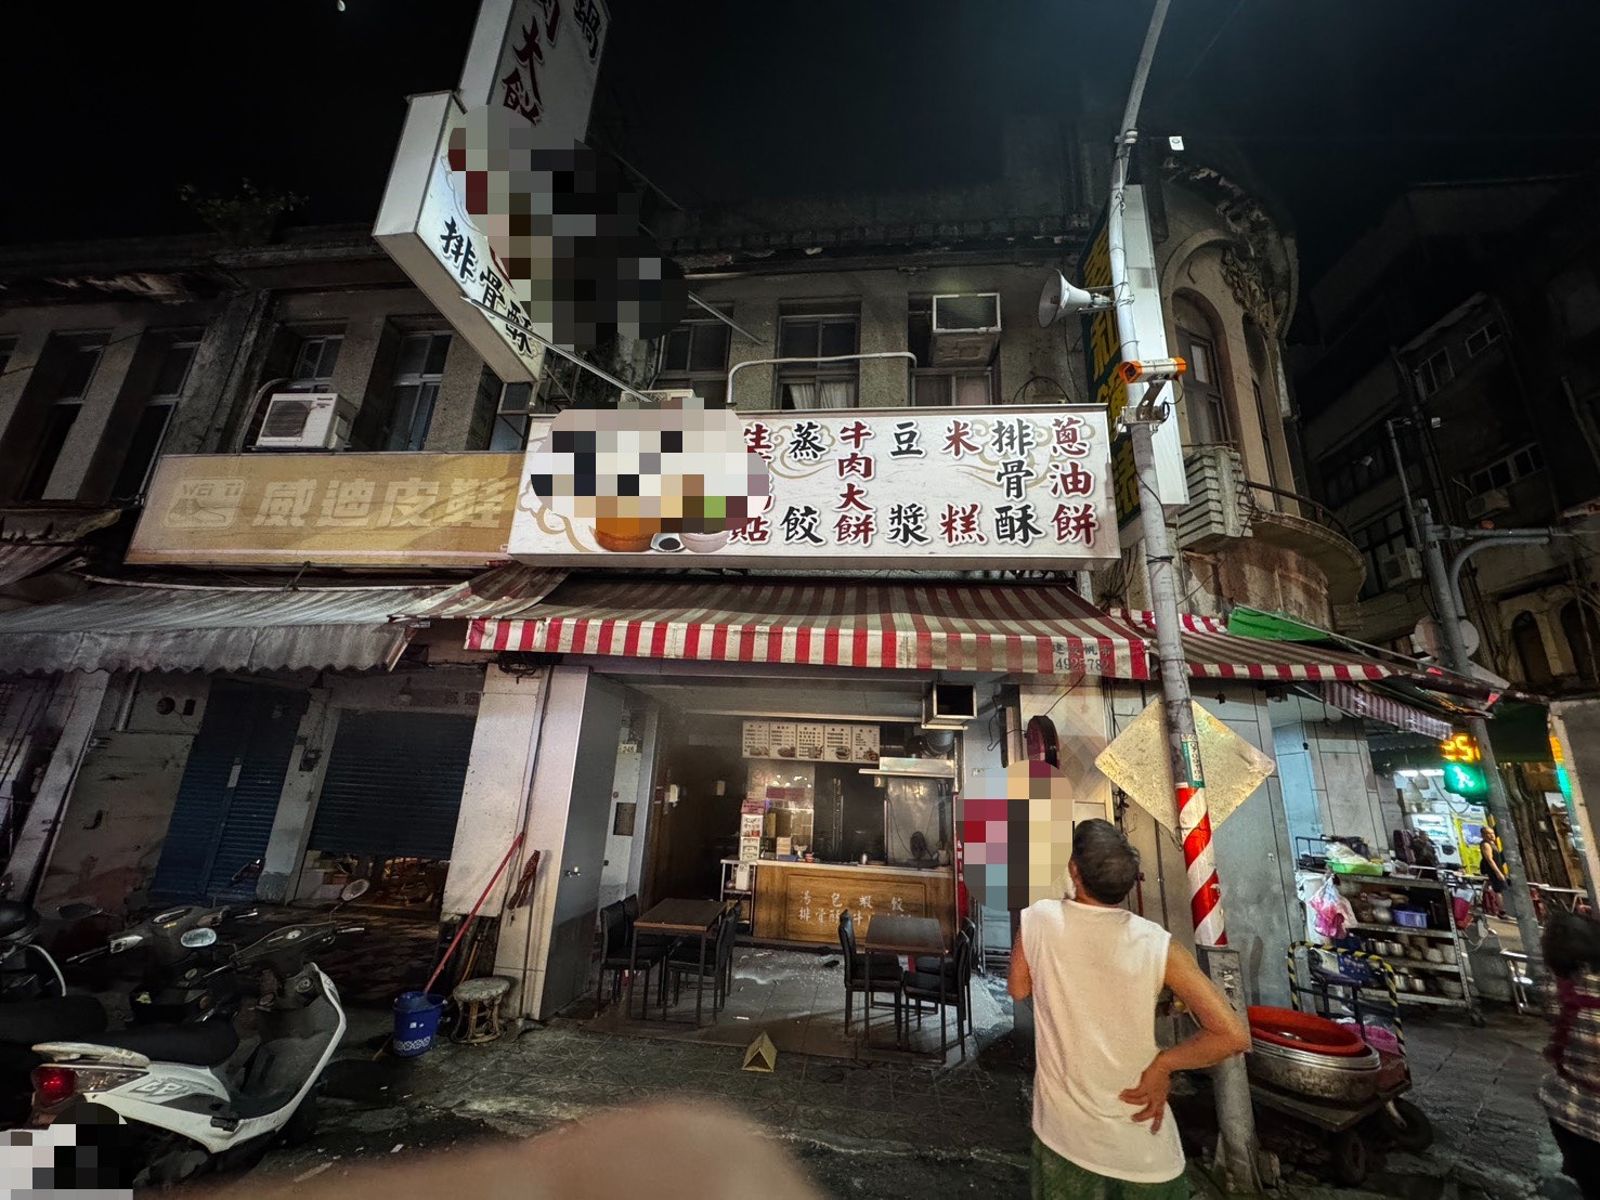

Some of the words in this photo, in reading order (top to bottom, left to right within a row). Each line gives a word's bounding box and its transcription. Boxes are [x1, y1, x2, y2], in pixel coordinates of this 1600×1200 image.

[440, 216, 534, 356] 排骨酥
[253, 477, 507, 529] 威迪皮鞋
[781, 420, 826, 544] 蒸餃
[833, 420, 876, 545] 牛肉大餅
[888, 420, 928, 544] 豆漿
[940, 419, 987, 543] 米糕
[991, 417, 1042, 544] 排骨酥
